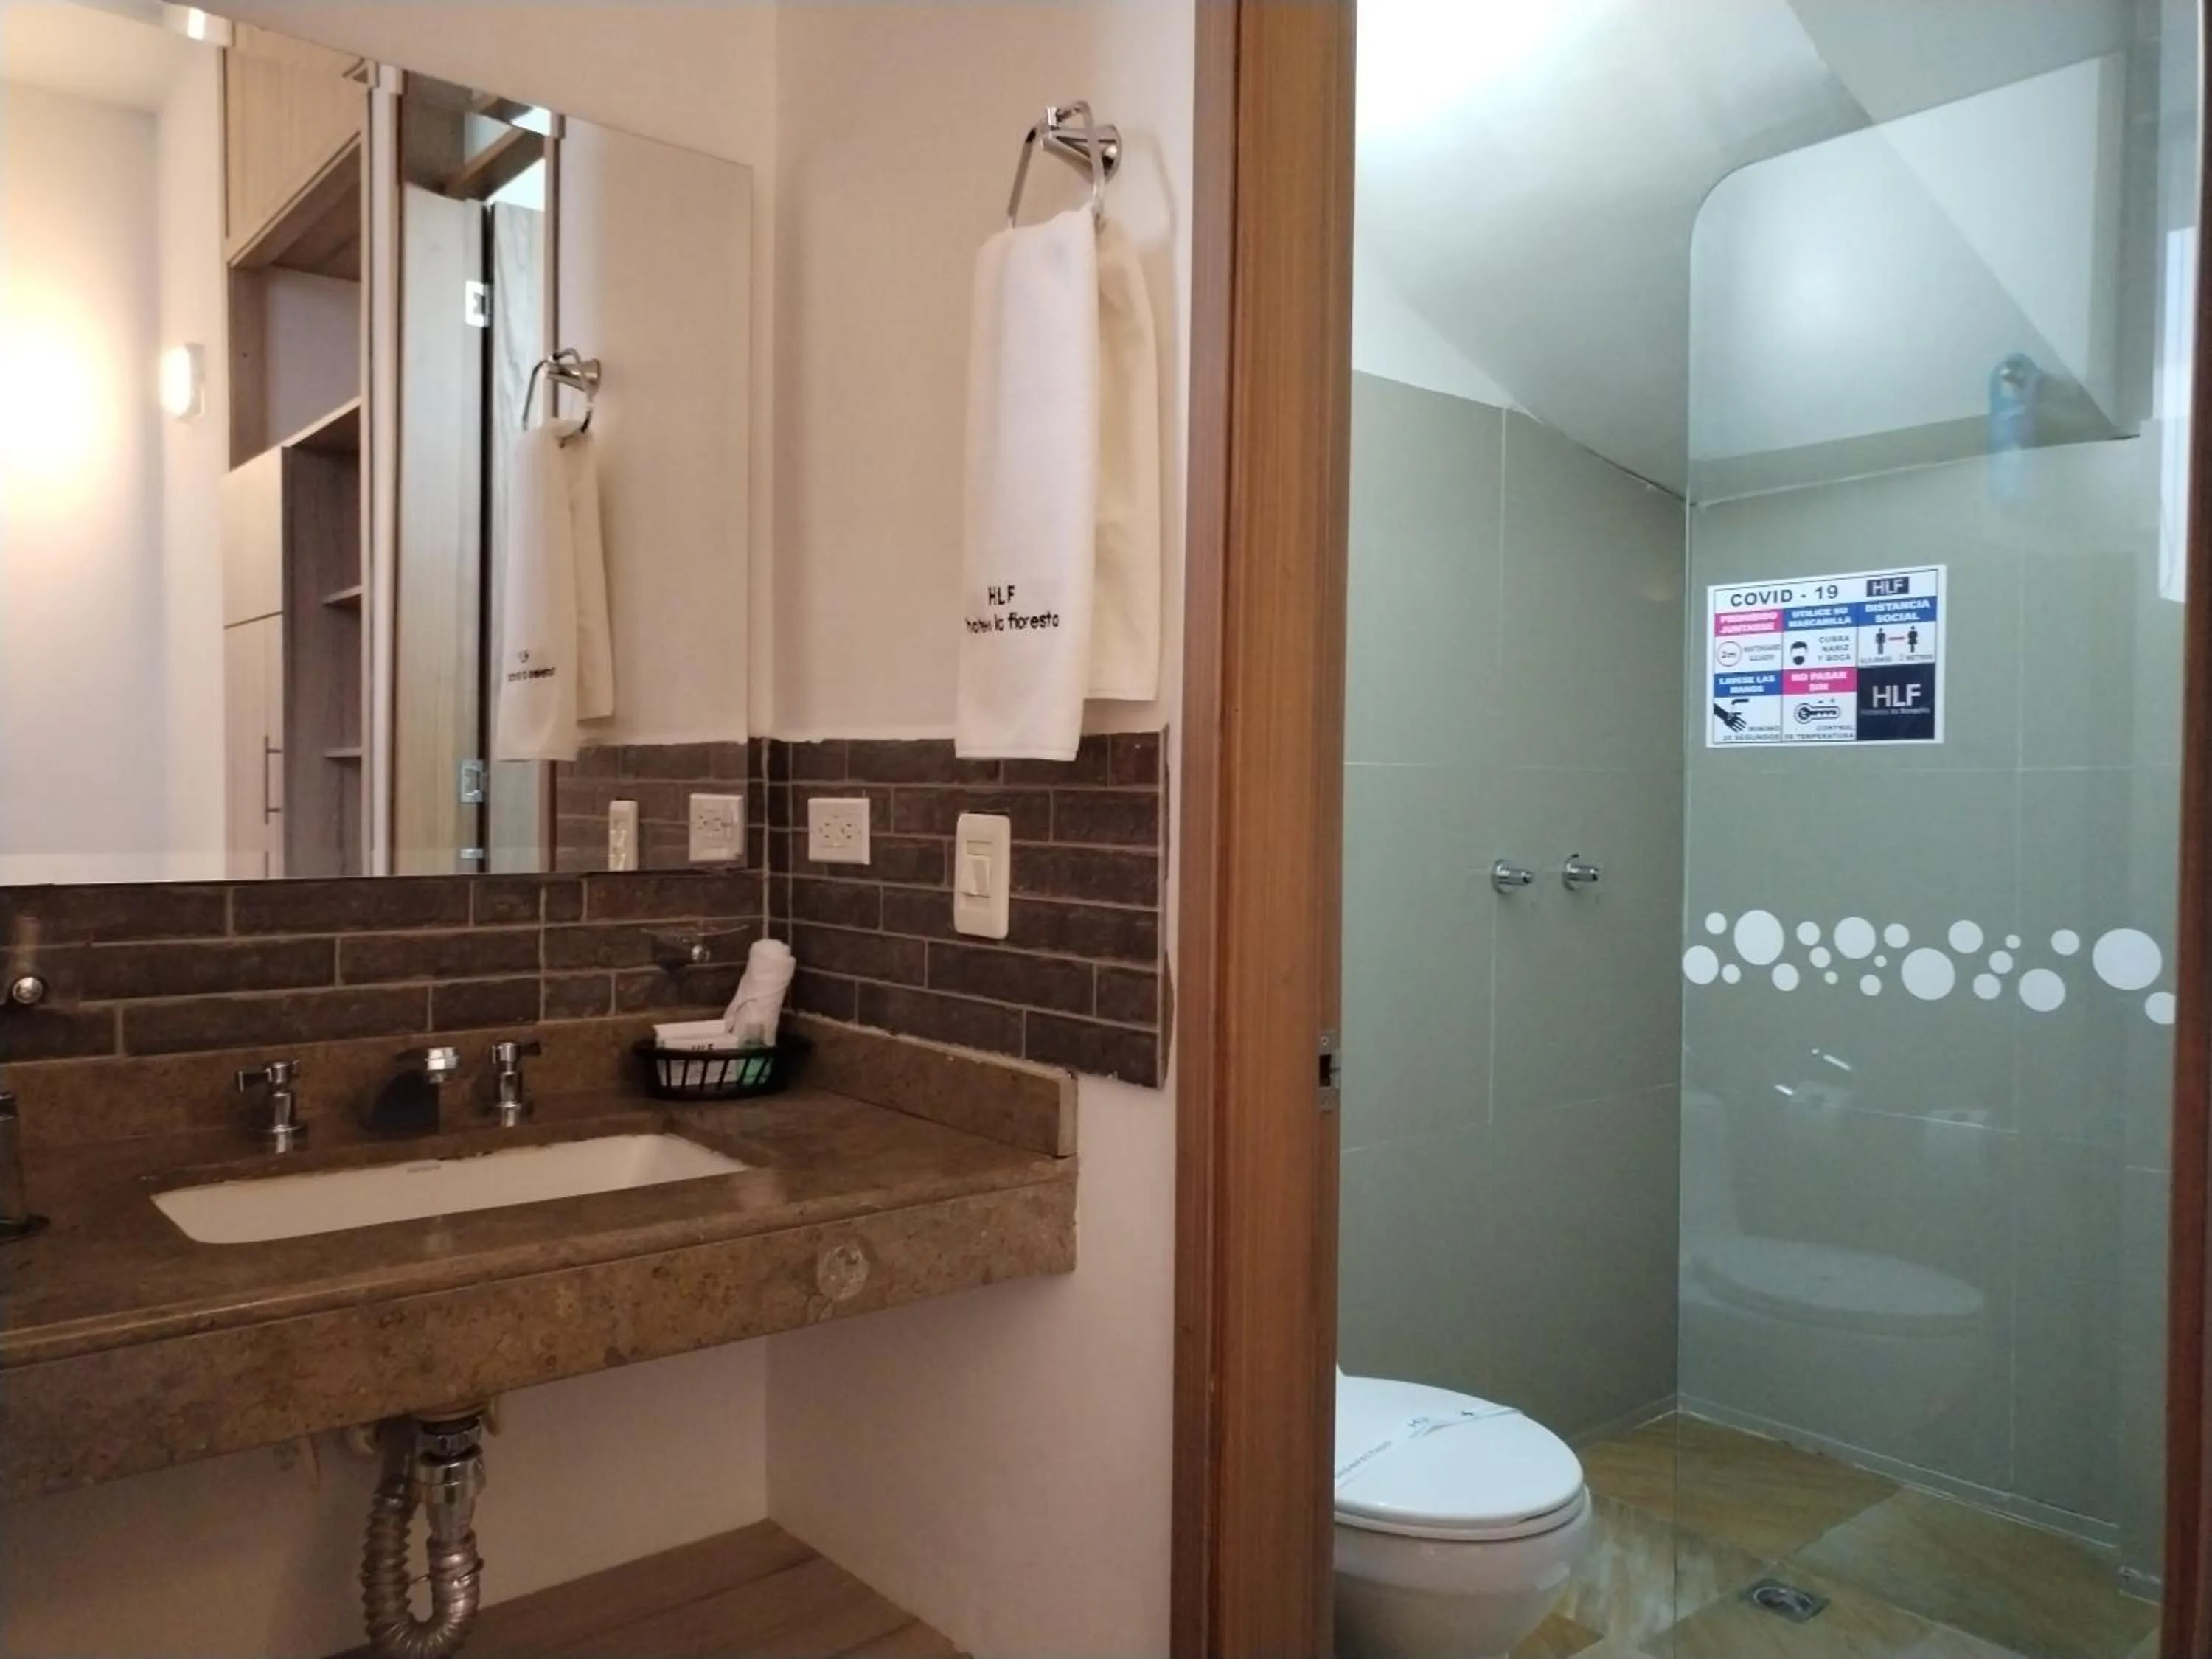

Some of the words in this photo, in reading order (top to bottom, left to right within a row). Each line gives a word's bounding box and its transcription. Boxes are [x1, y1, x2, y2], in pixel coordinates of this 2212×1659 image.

[988, 585, 1015, 605] HLF
[1872, 578, 1905, 595] HLF
[1730, 589, 1792, 607] COVID
[1815, 585, 1839, 599] 19
[1864, 599, 1931, 613] DISTANCIA
[1875, 612, 1920, 624] SOCIAL
[1818, 635, 1851, 644] CUBRA
[1872, 683, 1922, 709] HLF
